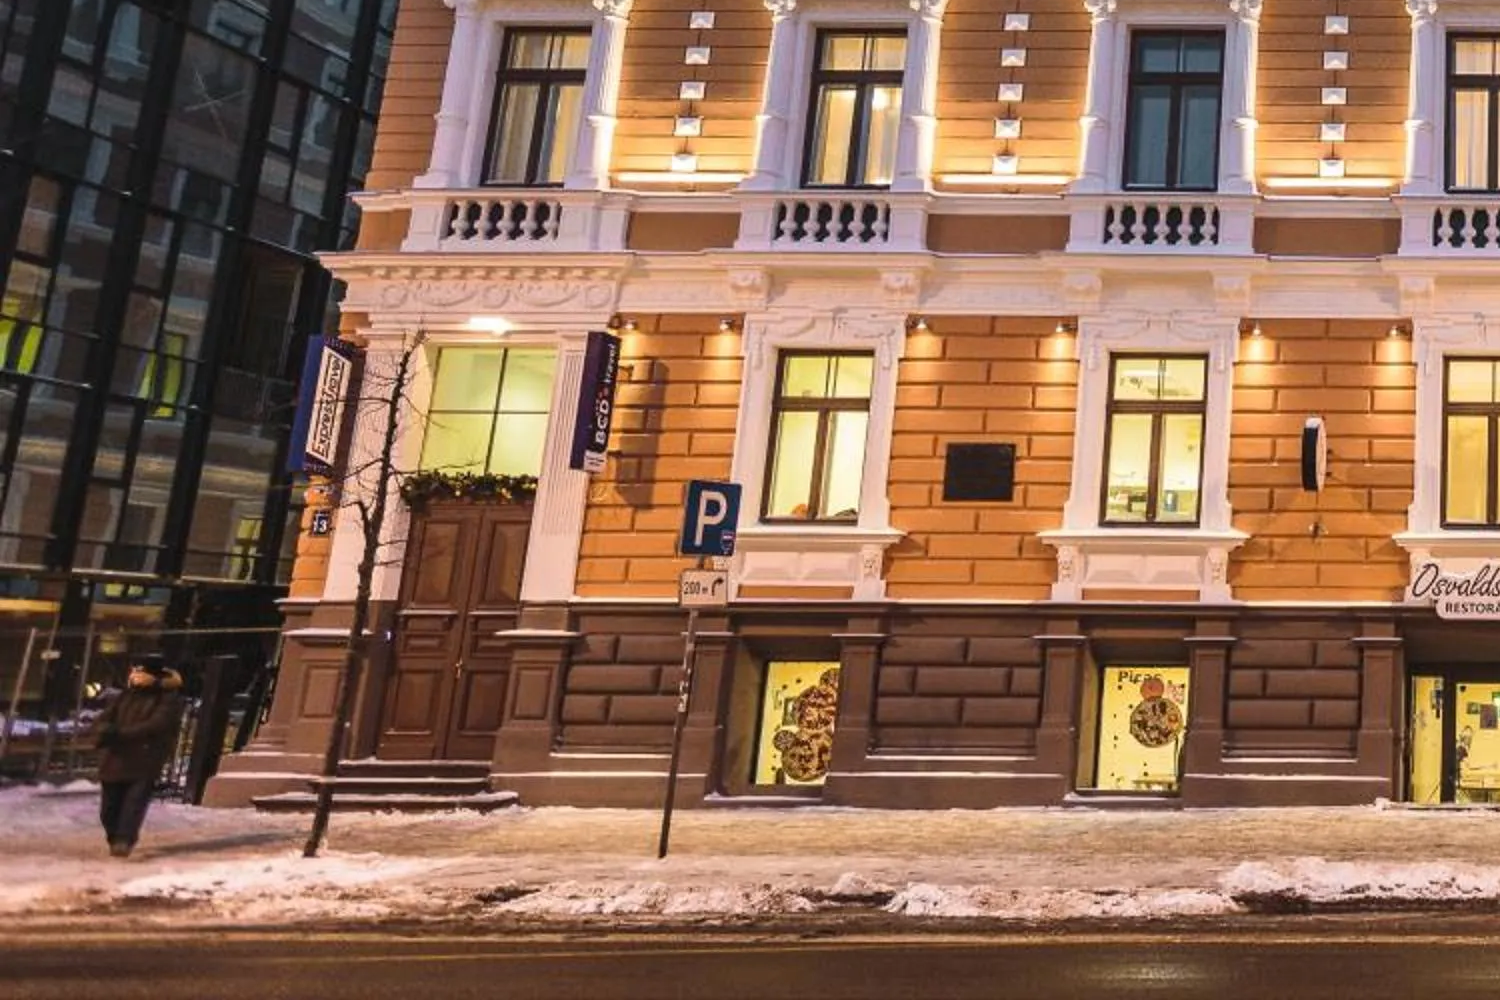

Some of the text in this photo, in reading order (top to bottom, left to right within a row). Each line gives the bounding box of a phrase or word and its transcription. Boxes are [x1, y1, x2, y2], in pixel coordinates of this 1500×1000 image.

[595, 399, 609, 444] BCD
[694, 489, 728, 547] P
[683, 582, 701, 595] 200
